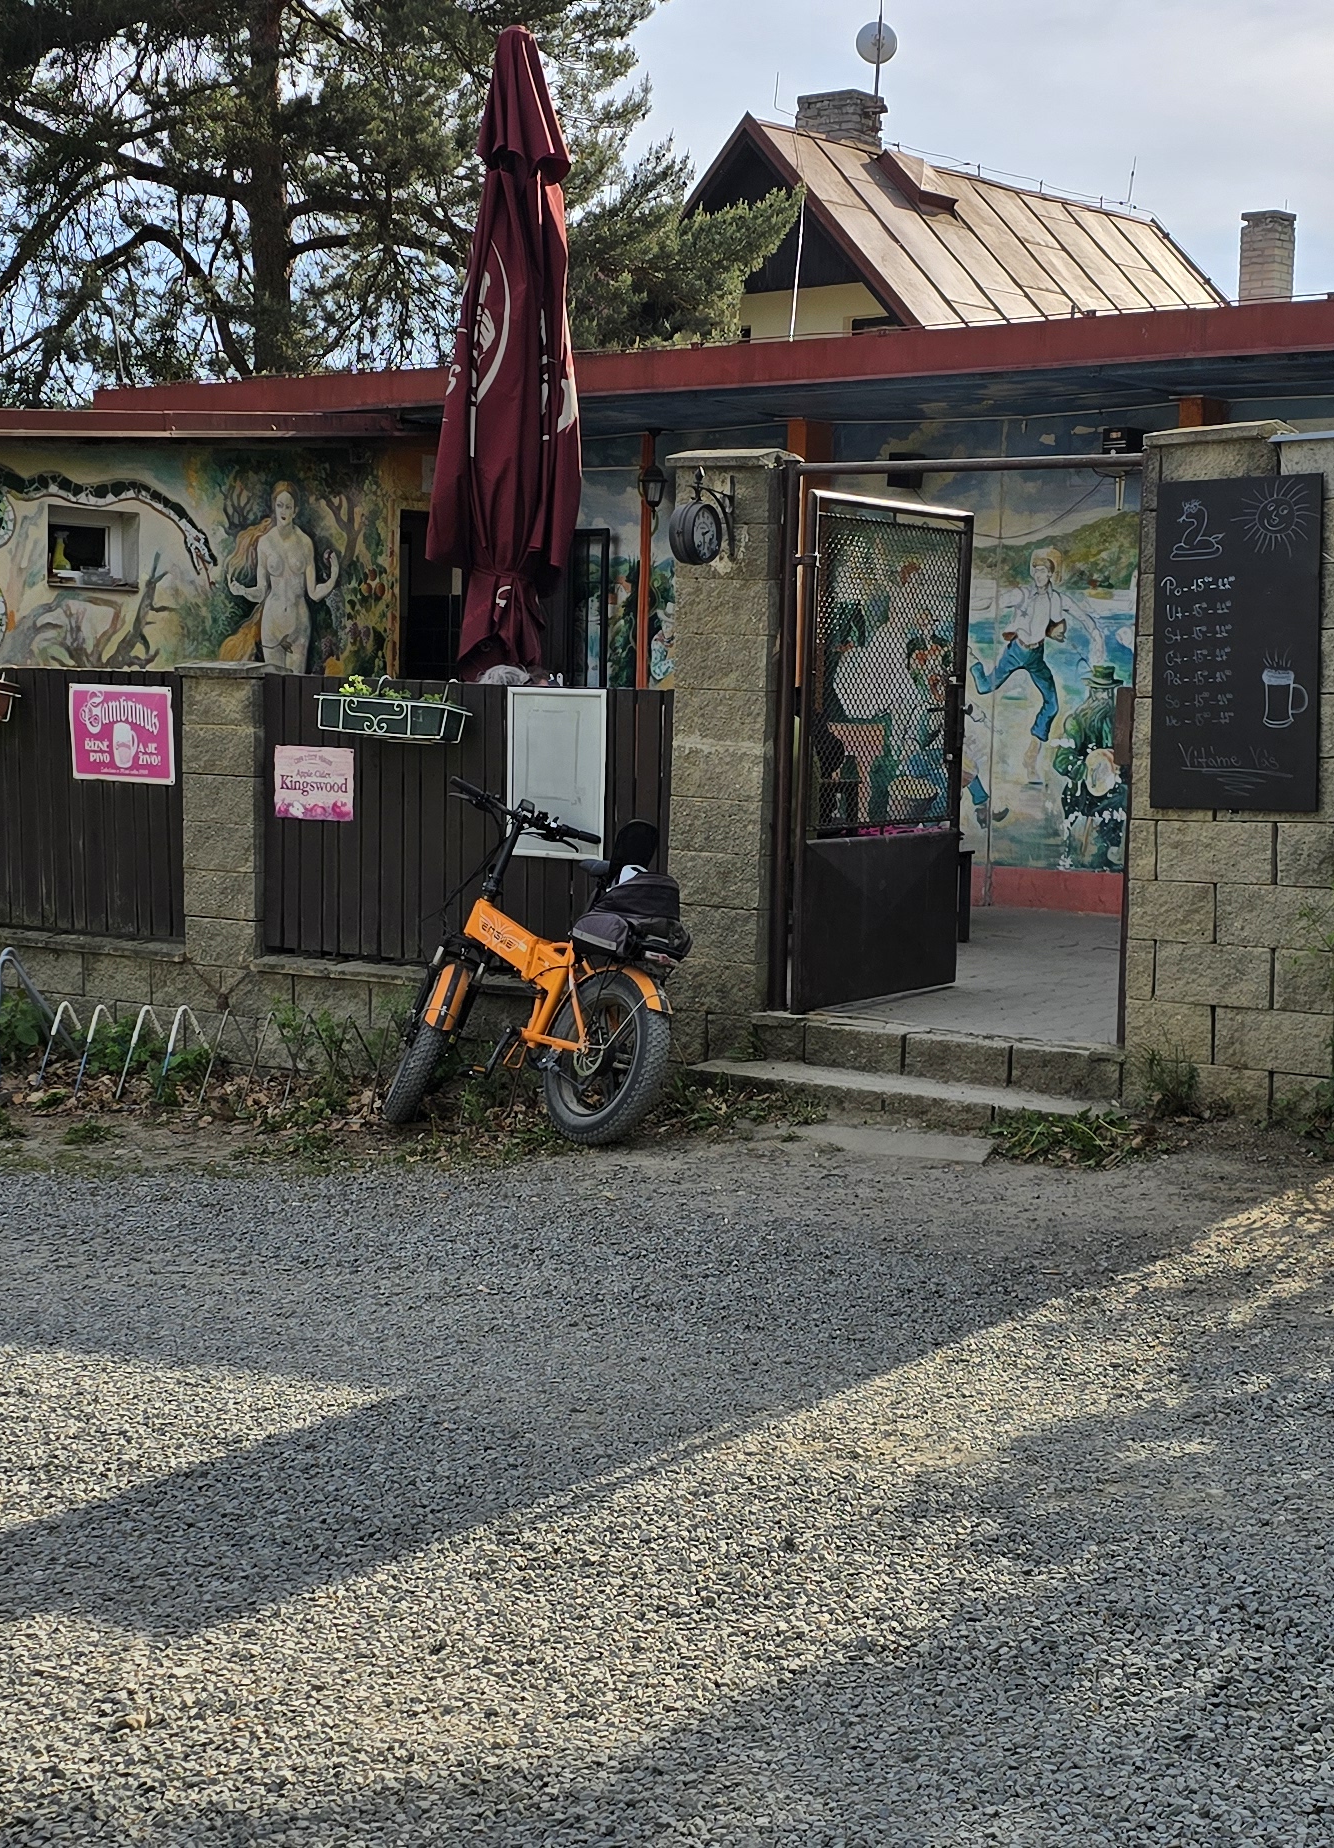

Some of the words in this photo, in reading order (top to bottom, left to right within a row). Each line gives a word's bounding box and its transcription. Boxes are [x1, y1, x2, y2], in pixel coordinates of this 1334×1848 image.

[1160, 576, 1182, 596] Po
[79, 689, 159, 735] Gambrinus
[84, 738, 109, 751] ŘÍZNÉ
[138, 743, 145, 753] A
[145, 743, 158, 754] JE
[89, 753, 110, 763] PIVO
[1178, 742, 1241, 768] Vitáme
[1249, 745, 1280, 769] Vás
[280, 774, 348, 796] Kingswood
